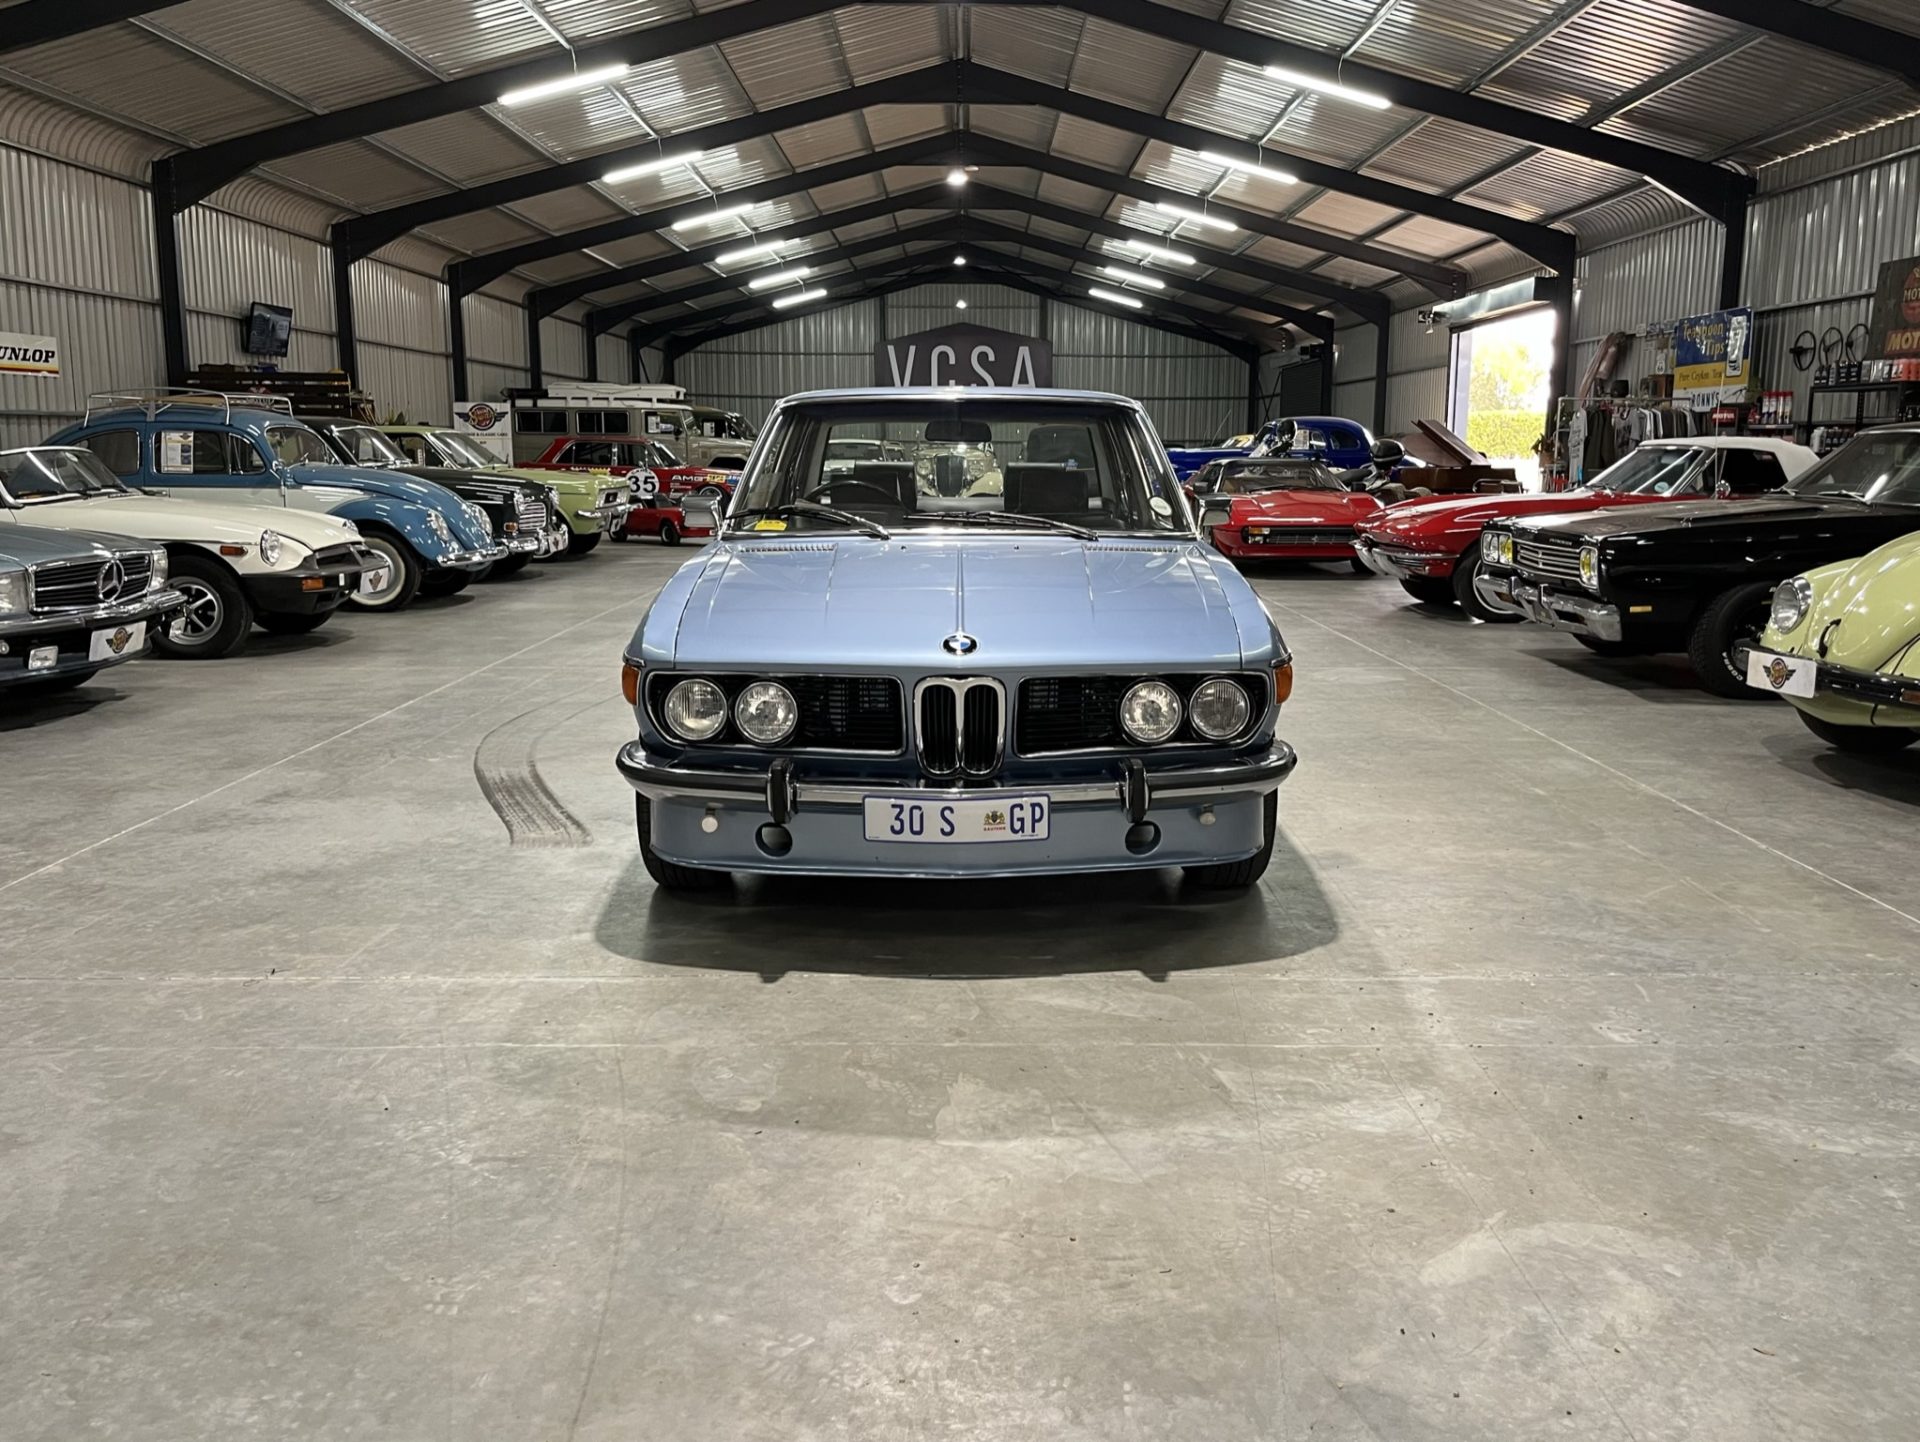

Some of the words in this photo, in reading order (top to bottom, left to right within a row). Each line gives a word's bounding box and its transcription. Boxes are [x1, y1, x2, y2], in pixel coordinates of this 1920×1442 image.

[0, 346, 56, 364] UNLOP
[887, 345, 1036, 388] VCSA
[628, 475, 657, 494] 35
[890, 803, 924, 836] 30
[940, 805, 956, 837] S
[1009, 802, 1045, 835] GP
